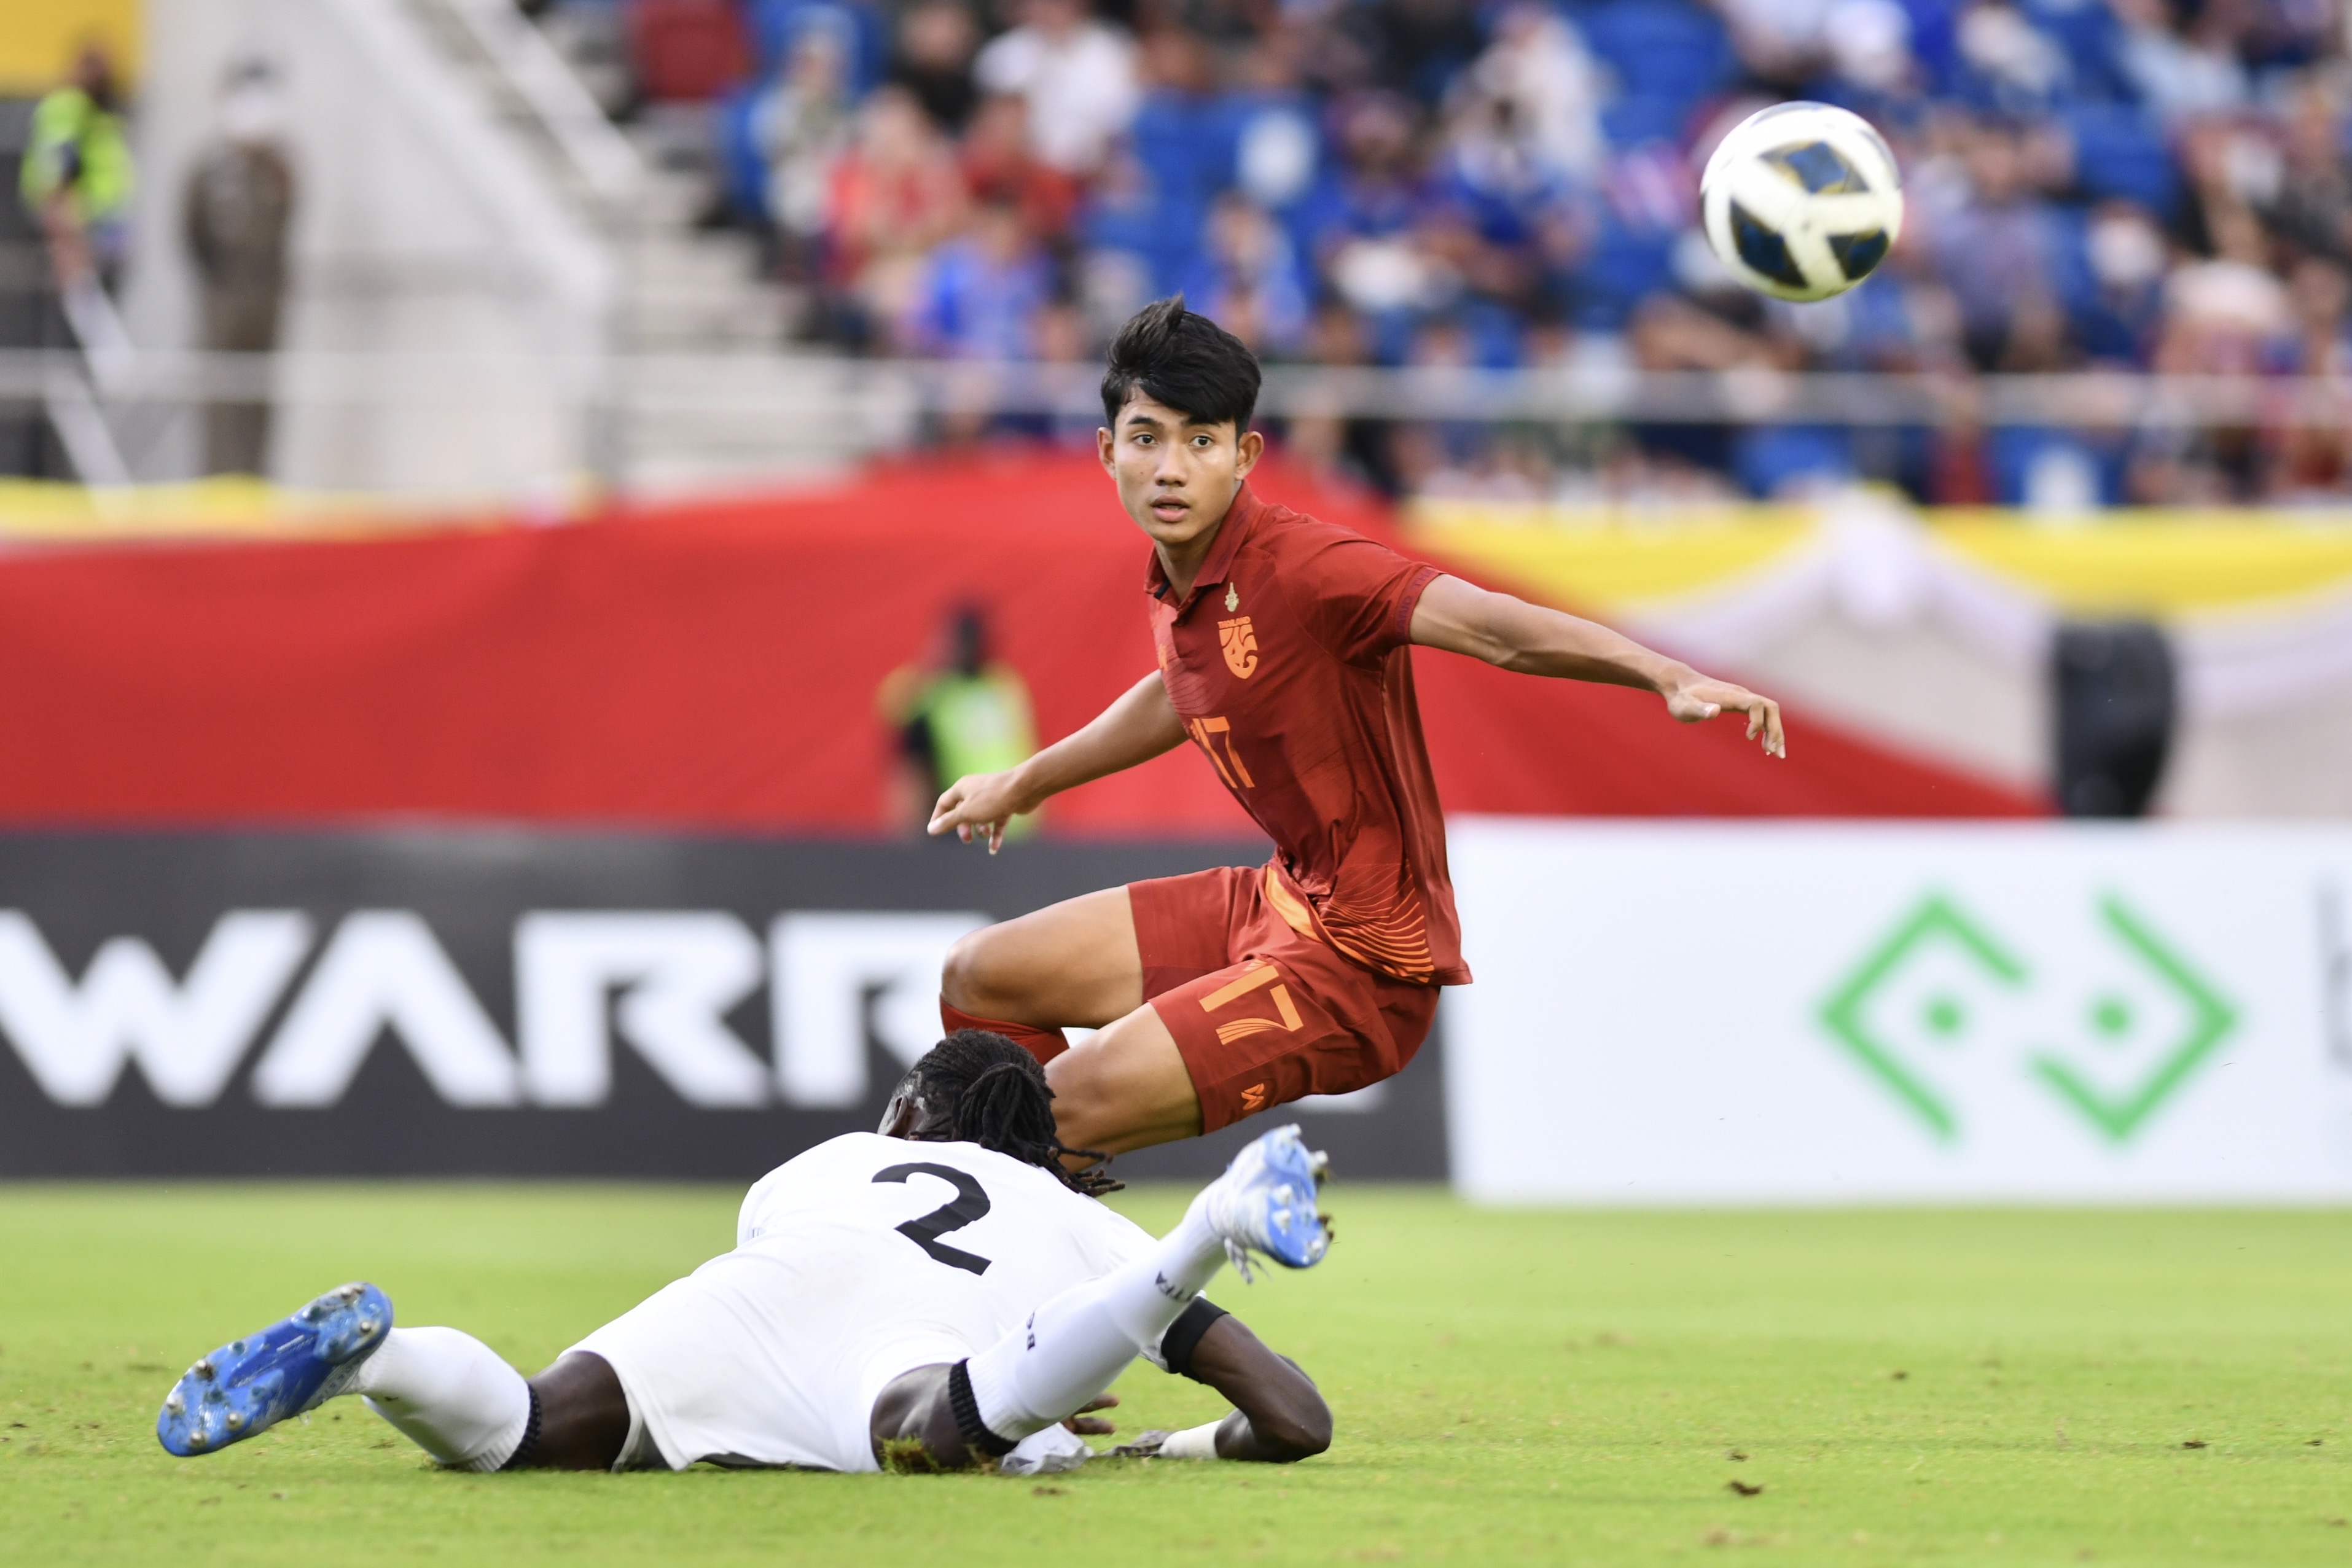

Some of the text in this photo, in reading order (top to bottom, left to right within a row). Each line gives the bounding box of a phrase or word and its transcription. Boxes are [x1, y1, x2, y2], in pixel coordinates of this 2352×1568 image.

[1190, 716, 1255, 789] 17
[0, 911, 1385, 1109] WARR
[1198, 959, 1304, 1045] 17
[871, 1162, 993, 1276] 2
